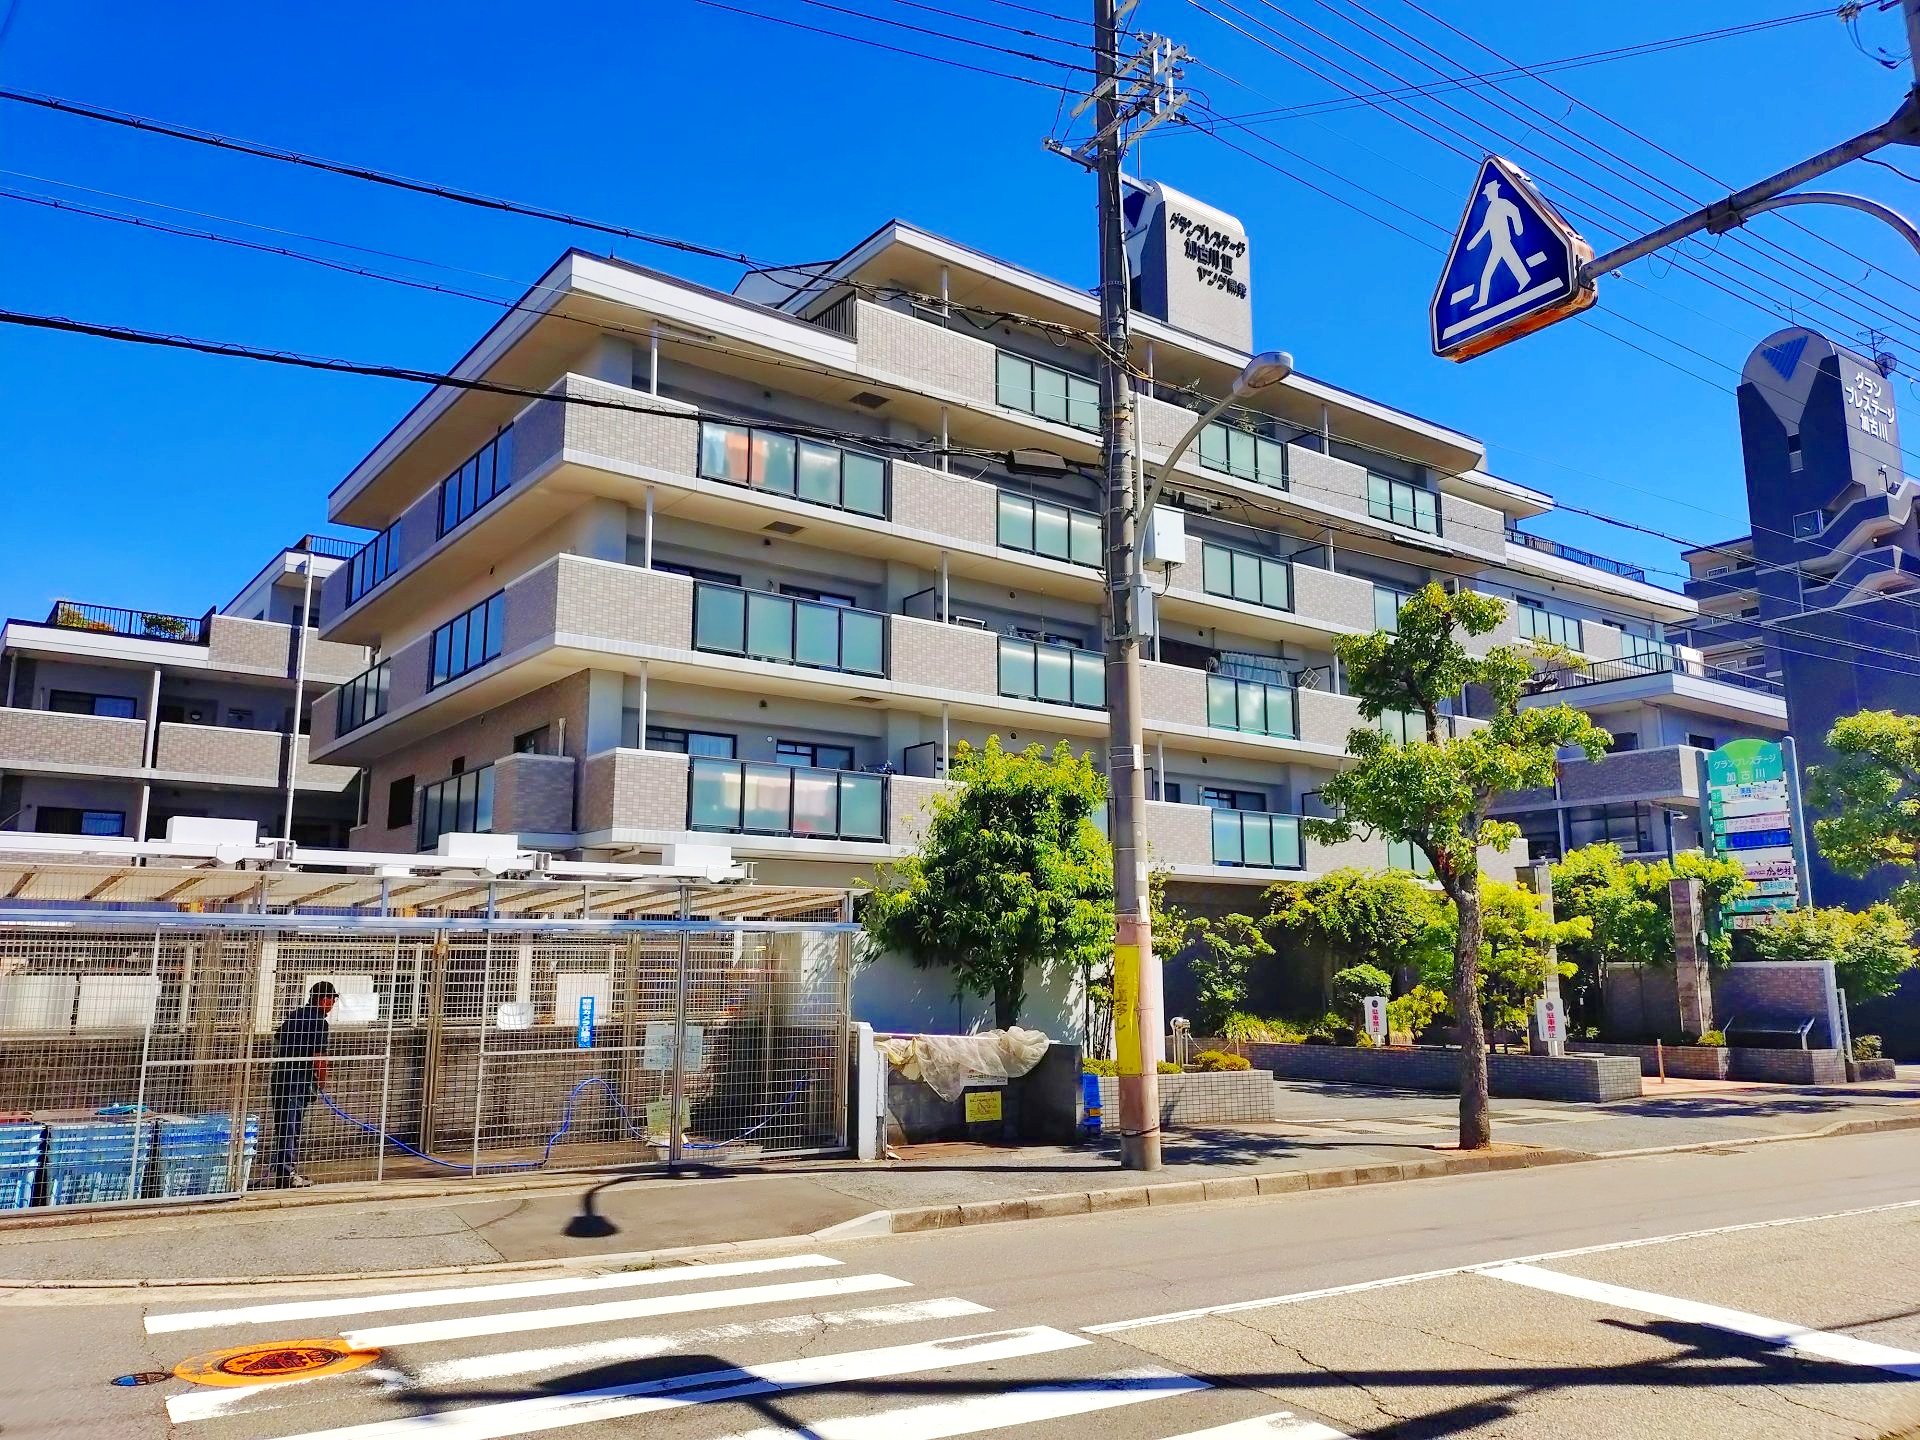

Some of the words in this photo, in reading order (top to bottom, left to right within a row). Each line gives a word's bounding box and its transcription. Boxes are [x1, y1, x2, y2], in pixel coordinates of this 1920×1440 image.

[1855, 371, 1881, 398] グラン
[1860, 412, 1888, 441] 加古川
[1371, 1008, 1380, 1033] 駐車禁止
[1546, 1012, 1557, 1039] 駐車禁止
